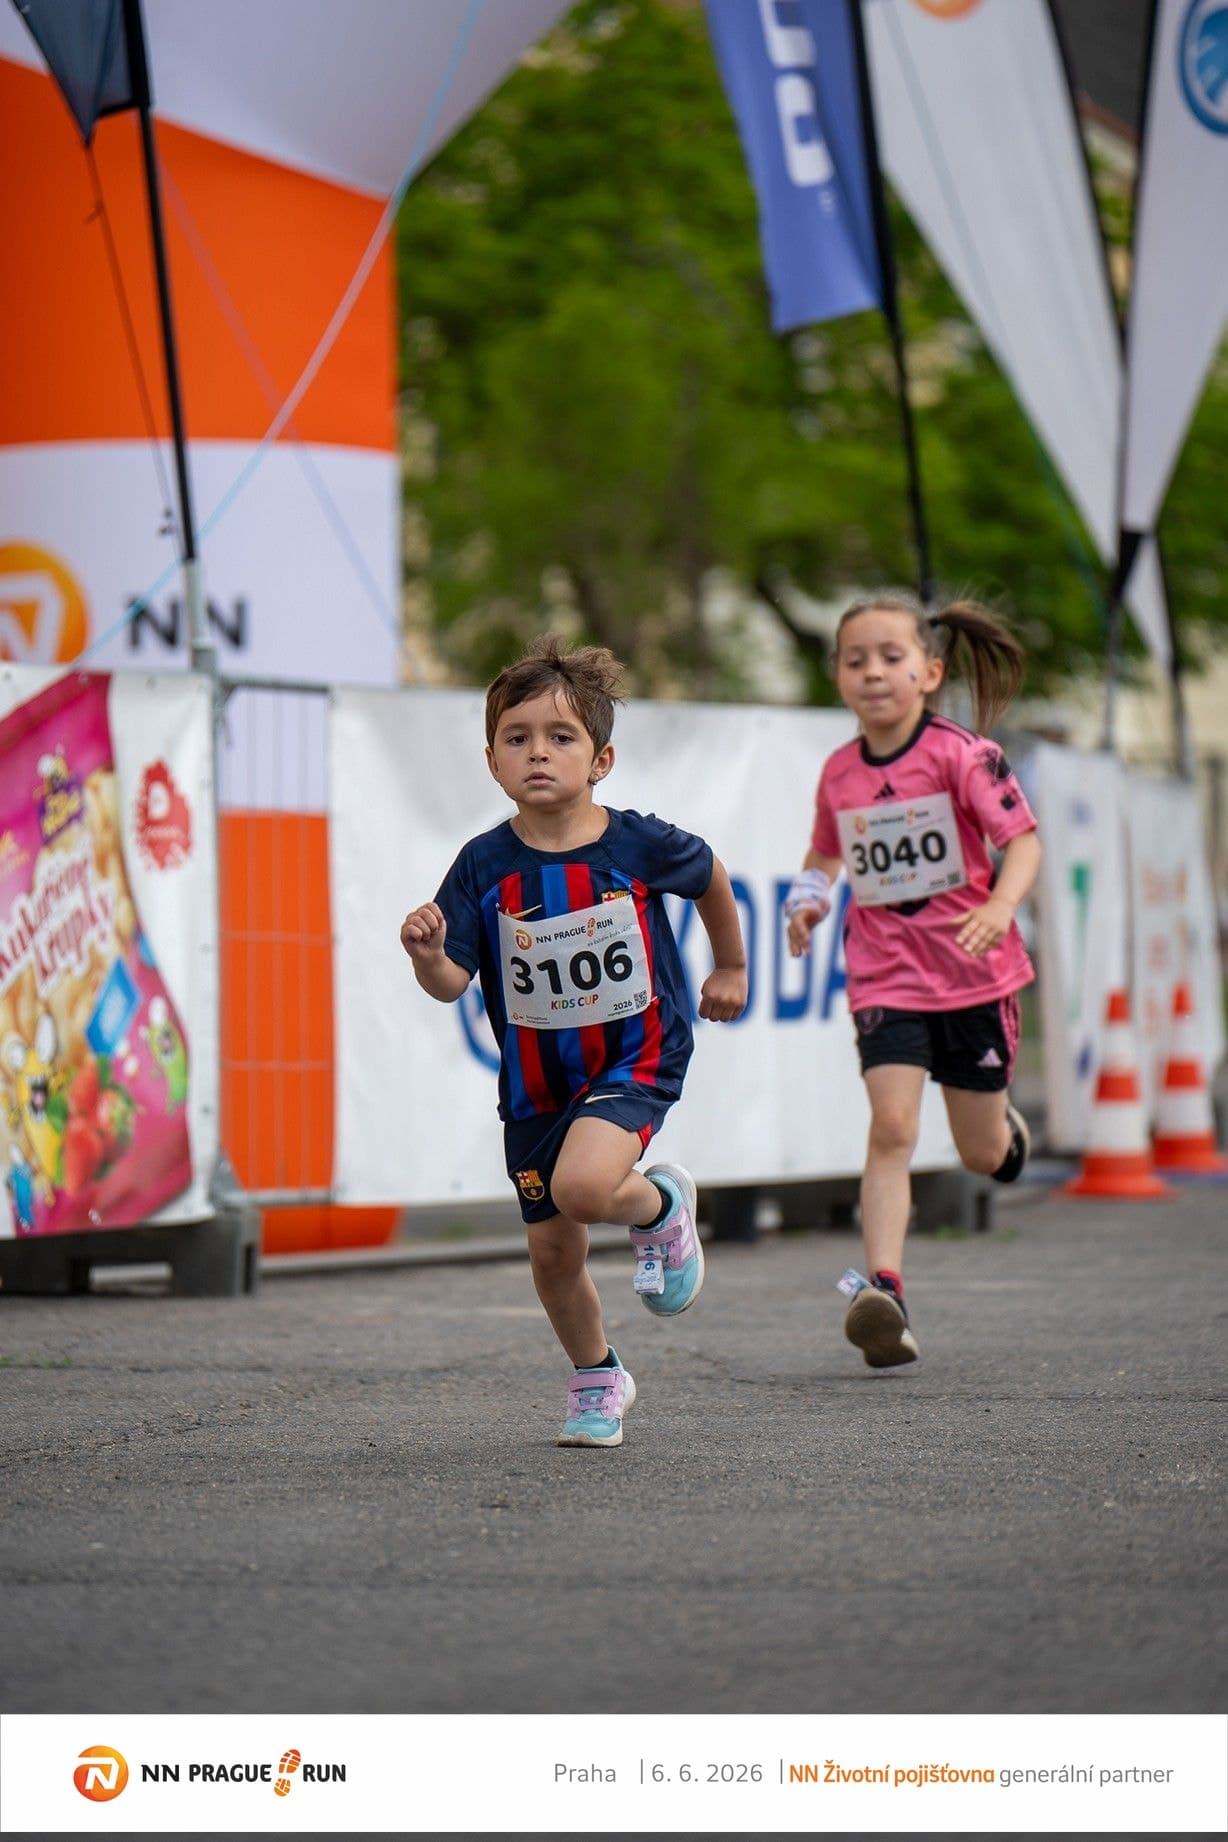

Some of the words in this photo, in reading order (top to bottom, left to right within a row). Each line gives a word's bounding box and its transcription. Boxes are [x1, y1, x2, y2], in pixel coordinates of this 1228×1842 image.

[129, 597, 246, 648] NN
[851, 830, 947, 876] 3040
[536, 934, 552, 944] NN
[554, 925, 586, 941] PRAGUE
[597, 918, 613, 929] RUN
[510, 940, 633, 995] 3106
[551, 998, 576, 1010] KIDS
[577, 994, 599, 1006] CUP
[613, 1000, 633, 1011] 2026
